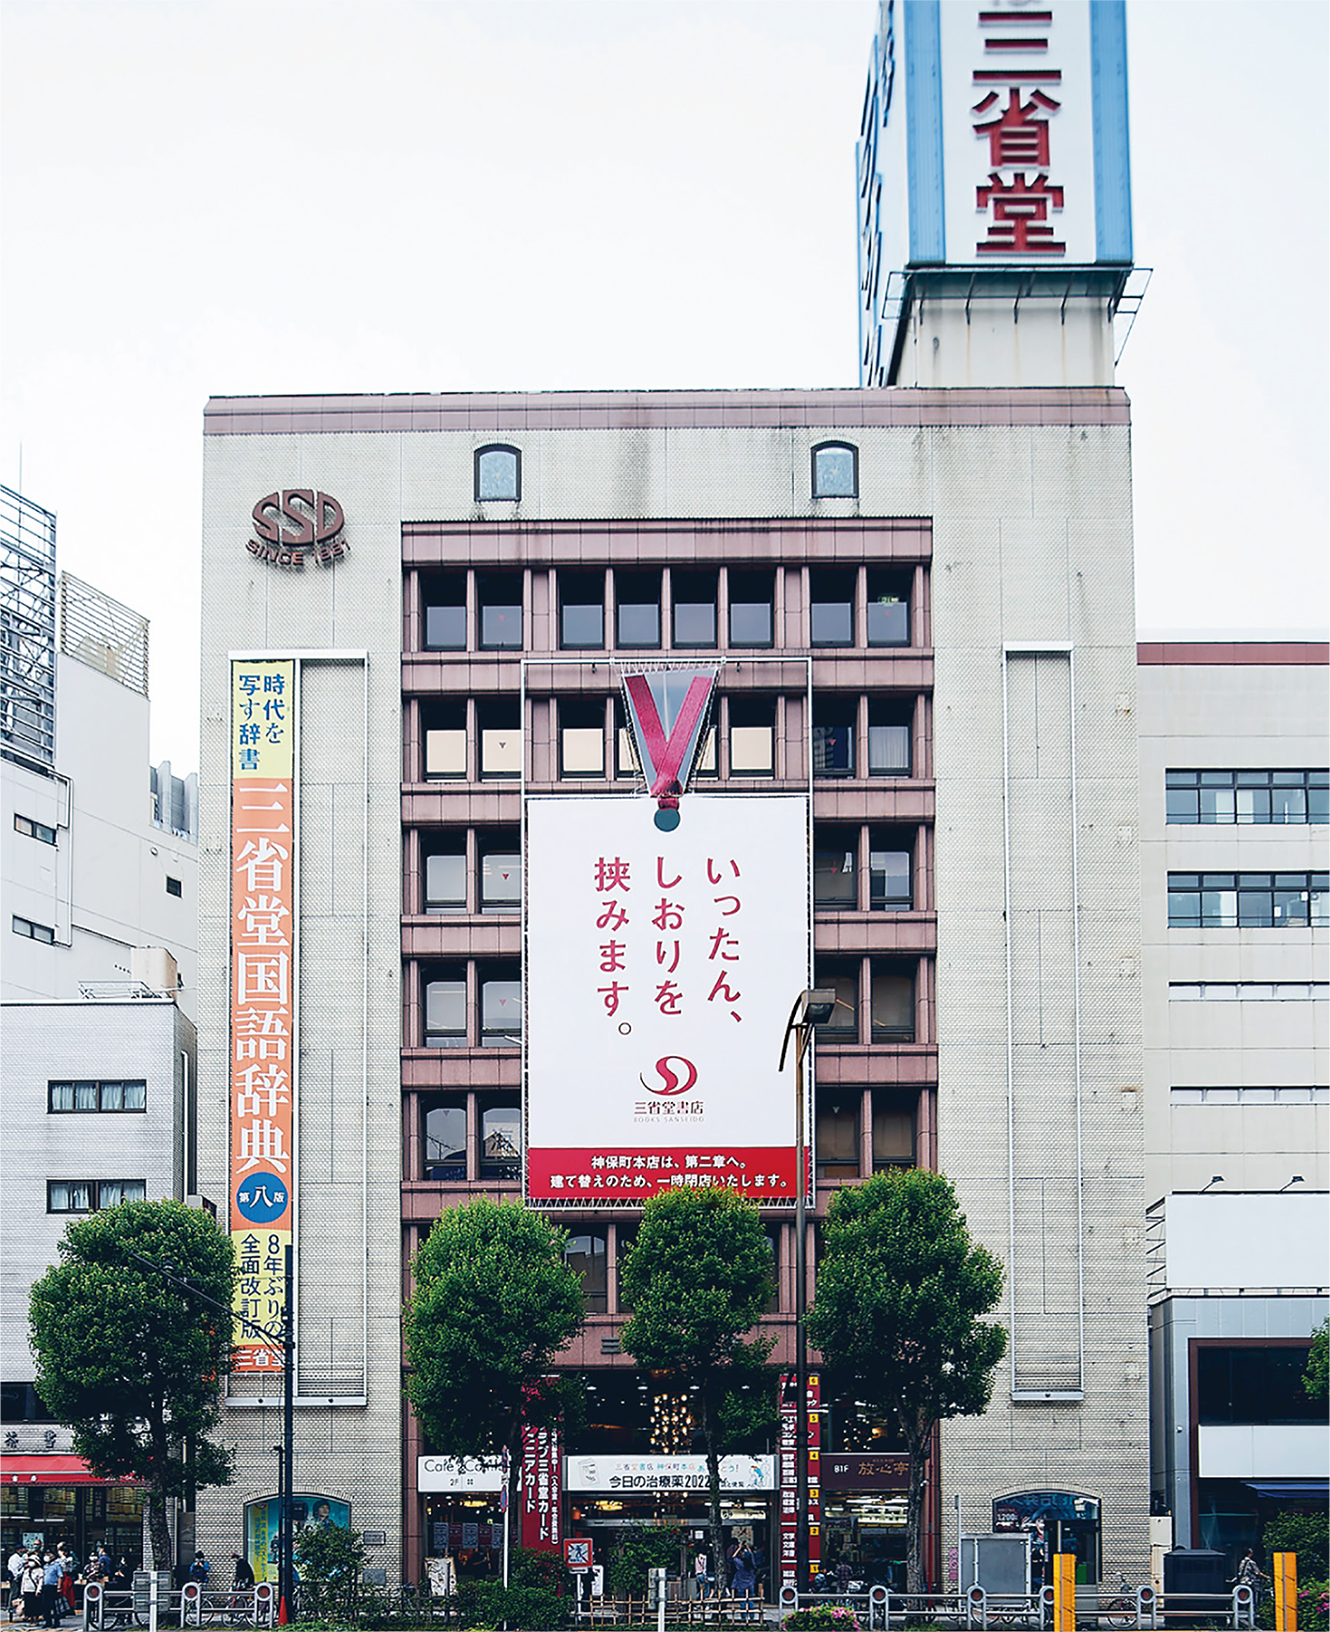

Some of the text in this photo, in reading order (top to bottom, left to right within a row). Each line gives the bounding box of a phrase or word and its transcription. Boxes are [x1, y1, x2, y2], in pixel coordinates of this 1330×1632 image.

[971, 0, 1066, 257] 三省堂
[245, 536, 351, 567] SINCE 1881
[252, 489, 345, 547] SSD
[239, 674, 260, 771] 写す辞書
[263, 673, 285, 744] 時代を
[236, 782, 290, 1174] 三省堂国語辞典
[594, 857, 632, 1036] 挟みます。
[651, 856, 685, 1016] しおりを
[706, 857, 742, 1023] いったん、
[633, 1100, 704, 1115] 三省堂書店
[239, 1185, 286, 1208] 第八版
[550, 1174, 788, 1189] 建て替えのため、一時閉店いたします。
[591, 1155, 746, 1170] 神保町本店は、第二章へ。
[240, 1233, 262, 1339] 全面改訂版
[263, 1233, 284, 1338] 8年ぶりの
[537, 1426, 550, 1541] ラブ三省堂カード
[609, 1474, 710, 1489] 今日の治療薬2022
[858, 1461, 910, 1476] 放心亭
